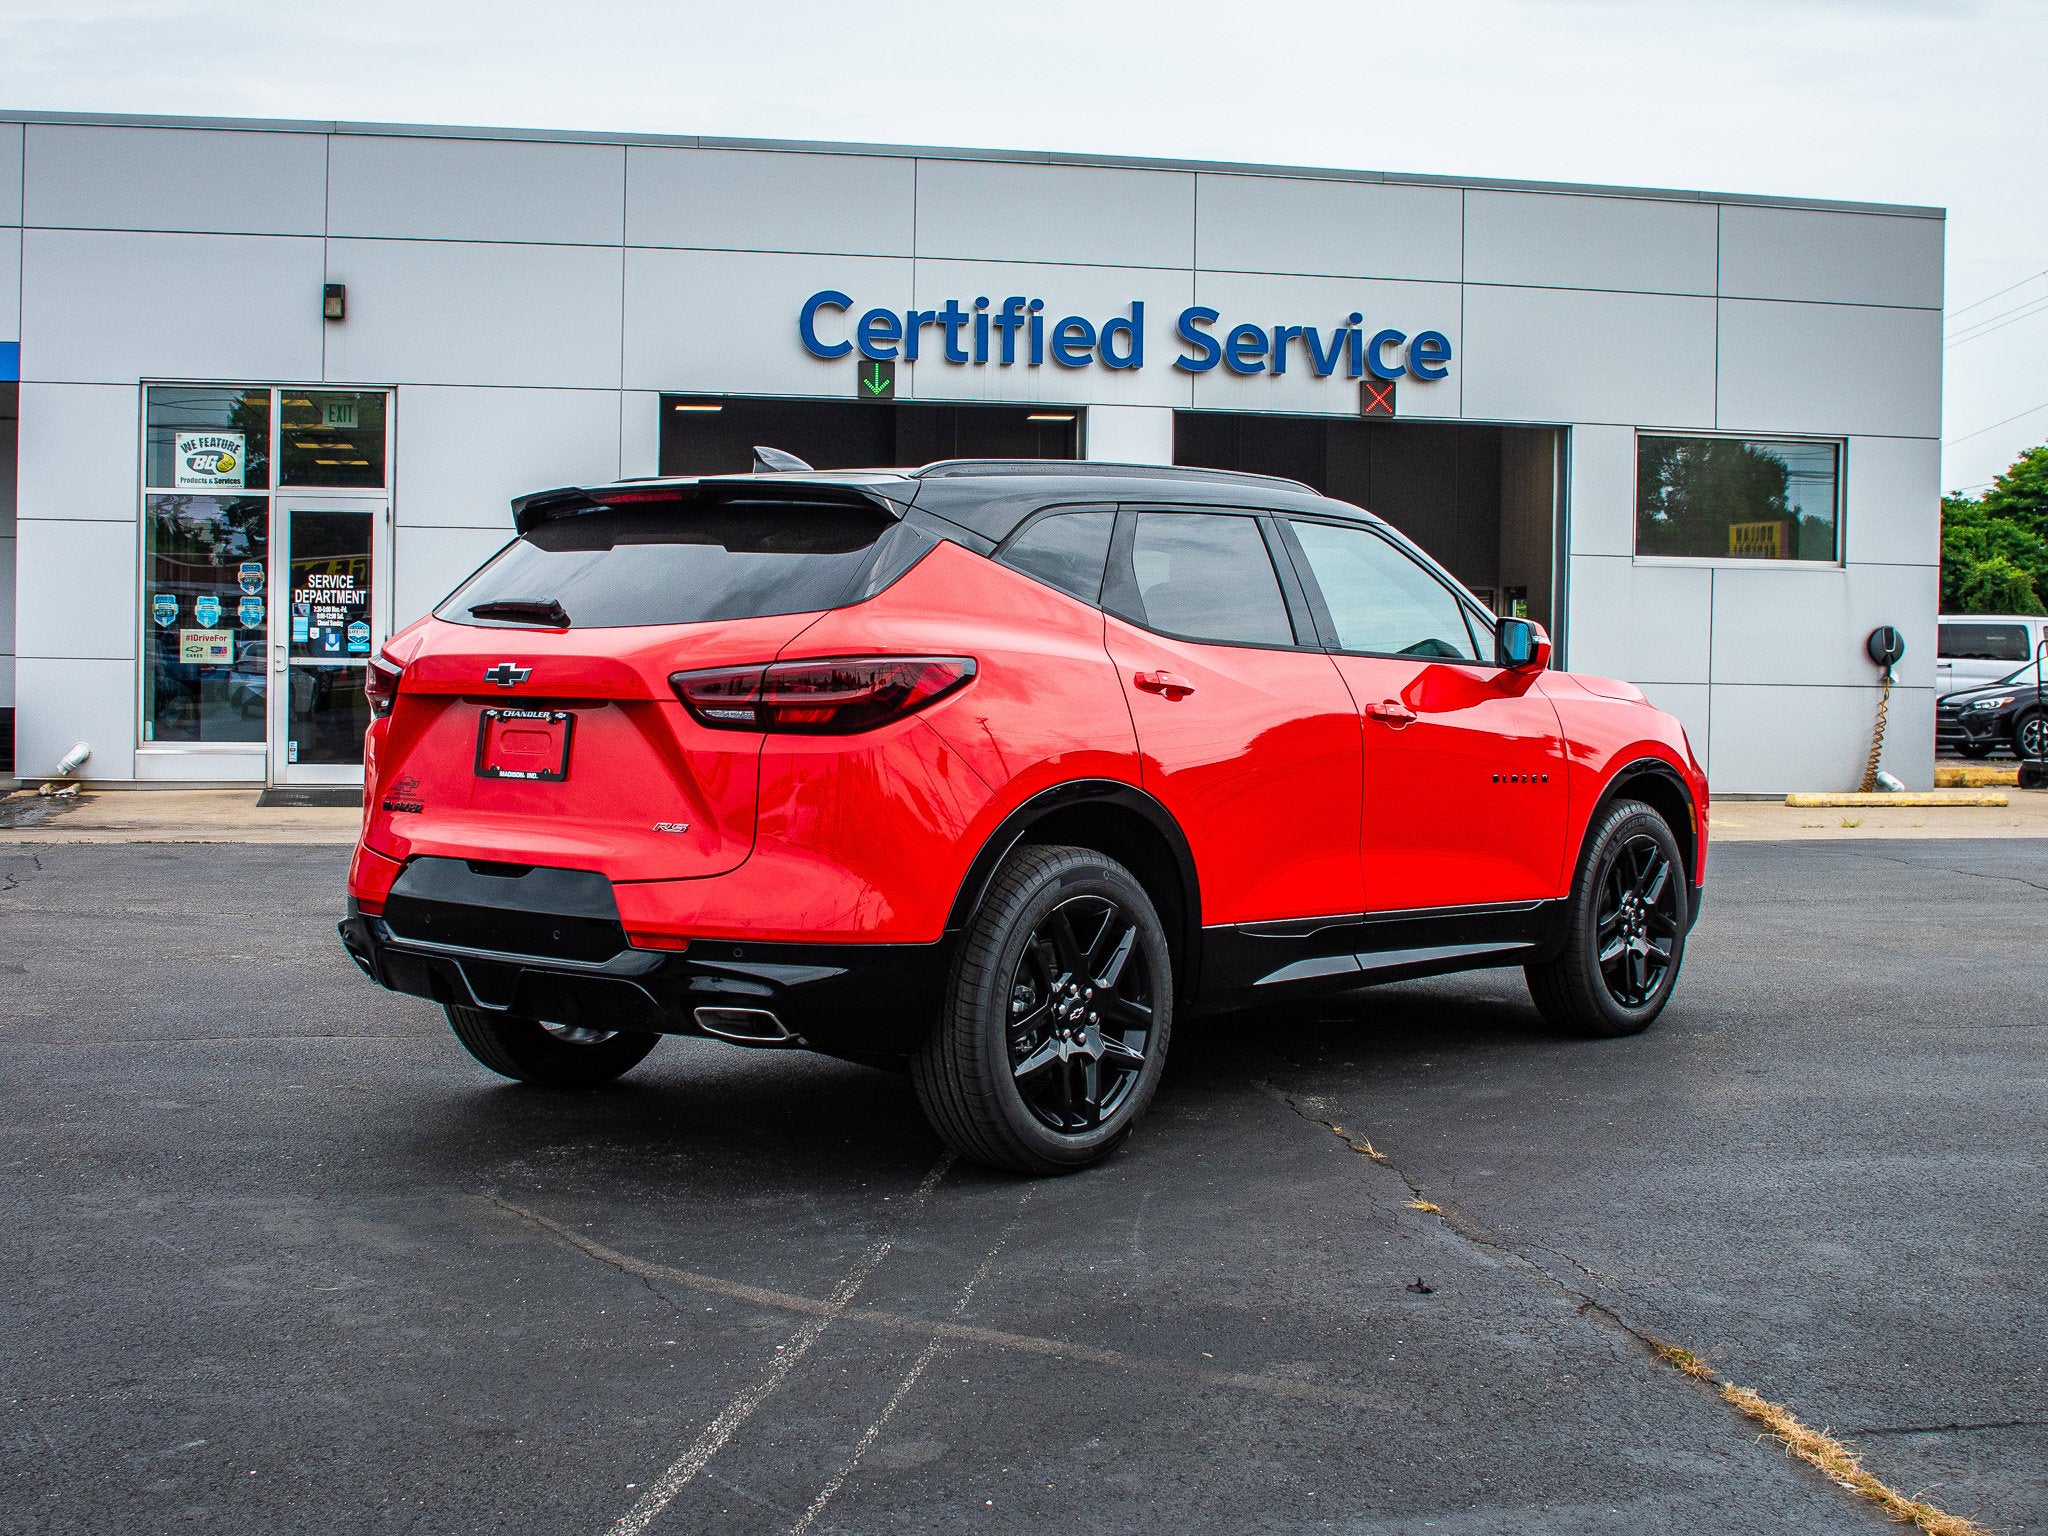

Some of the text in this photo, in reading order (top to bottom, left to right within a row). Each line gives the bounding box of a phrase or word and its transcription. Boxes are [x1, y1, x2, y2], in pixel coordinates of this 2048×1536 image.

[799, 289, 1452, 381] Certified Service
[328, 403, 353, 422] EXIT
[180, 437, 242, 454] WE FEATURE
[192, 454, 220, 470] BG
[308, 574, 354, 589] SERVICE
[294, 589, 367, 605] DEPARTMENT
[185, 633, 228, 642] #IDriveFor
[503, 710, 551, 718] CHANDLER
[652, 821, 690, 834] RS
